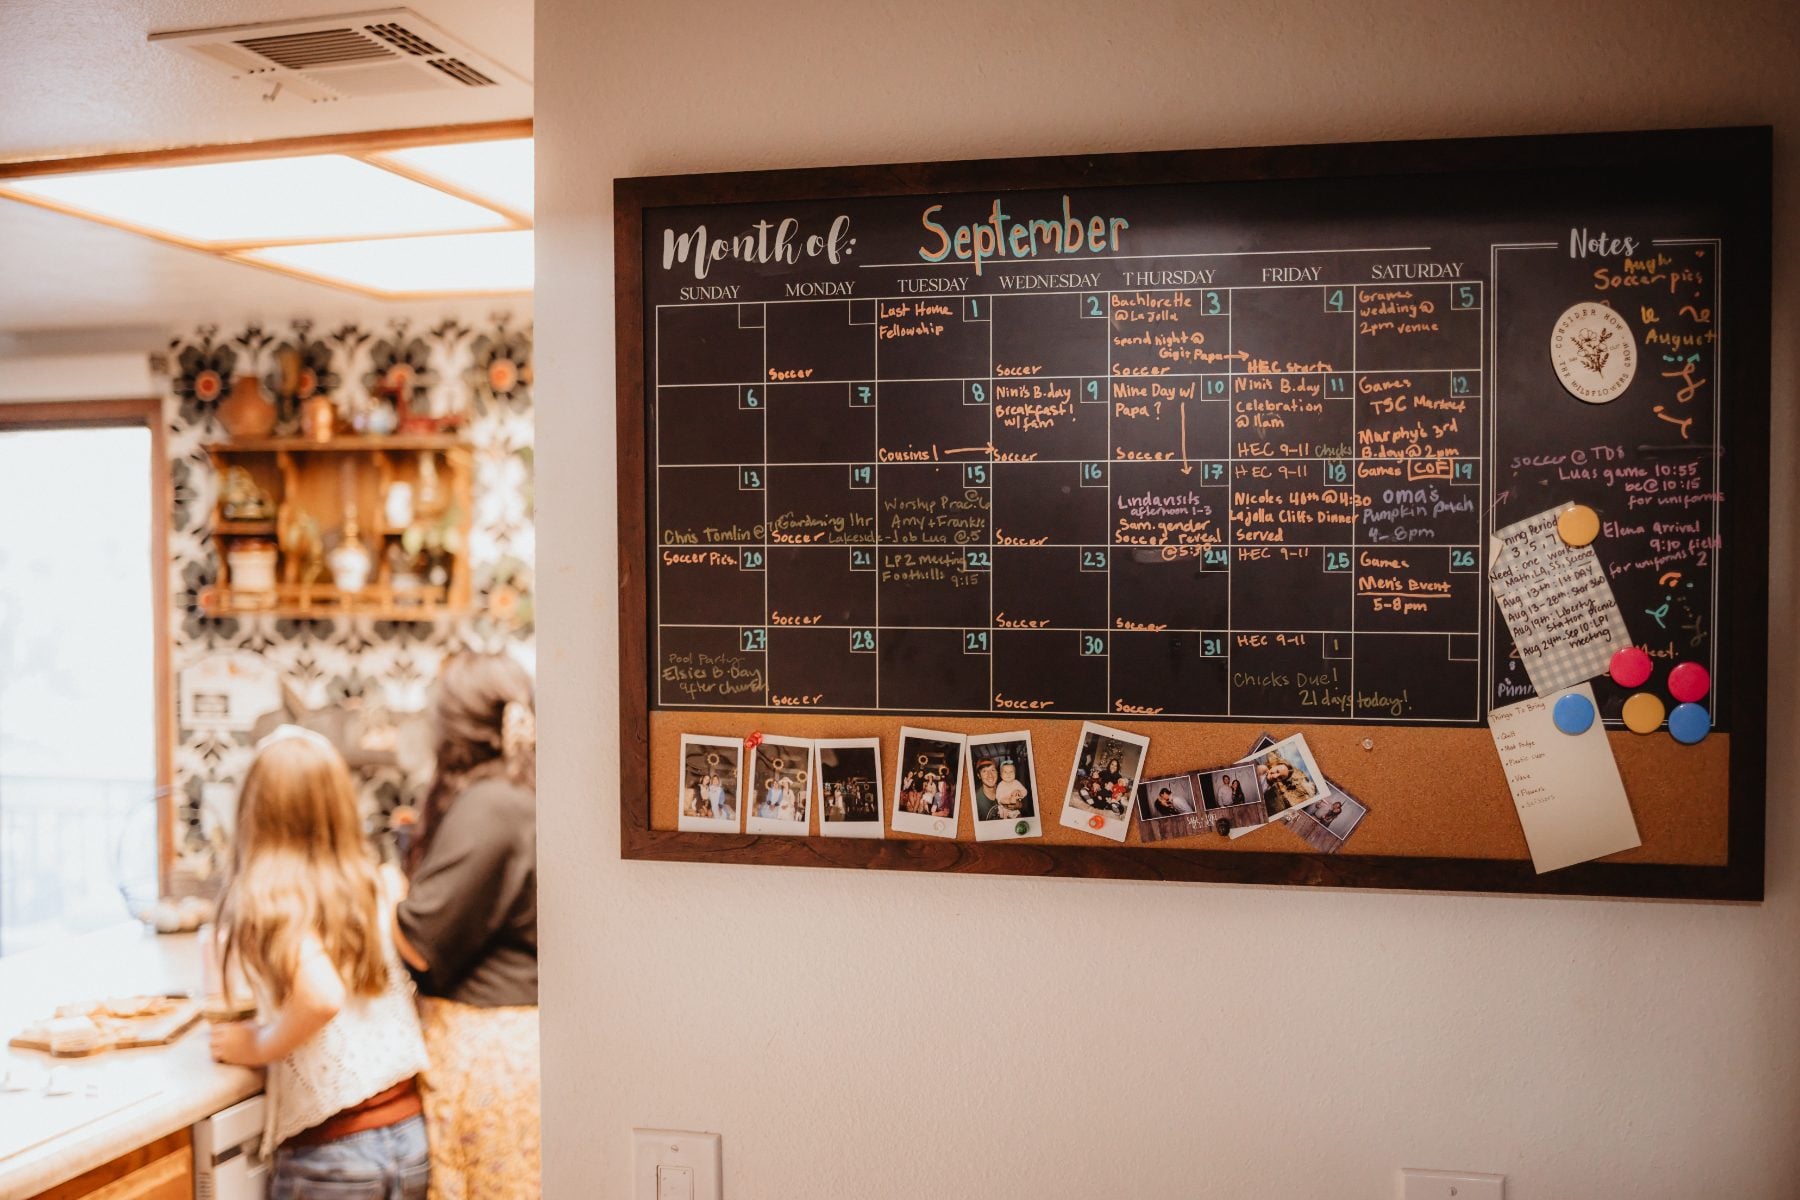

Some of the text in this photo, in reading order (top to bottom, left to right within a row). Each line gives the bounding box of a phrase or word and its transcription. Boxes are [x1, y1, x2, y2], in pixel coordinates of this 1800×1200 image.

[919, 194, 1129, 276] September
[1570, 227, 1640, 258] Notes
[662, 218, 802, 280] Month
[1122, 269, 1216, 286] THURSDAY
[1262, 266, 1322, 282] FRIDAY
[1371, 262, 1464, 280] SATURDAY
[897, 277, 969, 293] TUESDAY
[999, 272, 1101, 289] WEDNESDAY
[680, 284, 740, 300] SUNDAY
[785, 281, 855, 297] MONDAY
[1460, 286, 1474, 308] 5
[1087, 295, 1103, 316] 2
[1207, 291, 1221, 314] 3
[1329, 289, 1343, 312] 4
[880, 302, 953, 318] Last Home
[879, 323, 944, 340] Fellowship
[1360, 321, 1394, 336] 2pm
[768, 367, 813, 381] Soccer
[996, 364, 1042, 376] Soccer
[1112, 363, 1170, 376] Soccer
[972, 383, 985, 402] 8
[1087, 380, 1098, 400] 9
[1151, 383, 1176, 400] Day
[1208, 380, 1224, 395] 10
[1331, 378, 1344, 392] 11
[1358, 376, 1412, 393] Games
[747, 389, 758, 407] 6
[858, 386, 871, 404] 7
[993, 449, 1038, 462] Soccer
[1116, 447, 1175, 460] Soccer
[1238, 442, 1309, 457] HEC 9-11
[967, 465, 985, 484] 15
[1085, 463, 1102, 480] 16
[1204, 463, 1223, 480] 17
[1236, 464, 1307, 479] HEC 9-11
[1329, 463, 1346, 482] 18
[1358, 462, 1401, 478] Games
[1455, 463, 1472, 479] 19
[1655, 461, 1699, 477] 10:55
[744, 471, 760, 487] 13
[1663, 478, 1701, 490] 10:15
[891, 514, 926, 530] Amy
[703, 525, 750, 542] Tomlin
[772, 530, 825, 544] Soccer
[996, 529, 1048, 545] Soccer
[1115, 529, 1168, 545] Soccer
[663, 551, 707, 566] Soccer
[744, 551, 763, 568] 20
[853, 550, 870, 565] 21
[967, 552, 991, 566] 22
[1083, 552, 1106, 568] 23
[1204, 549, 1228, 565] 24
[1238, 547, 1309, 561] HEC 9-11
[1327, 552, 1350, 571] 25
[1452, 550, 1475, 567] 26
[1696, 552, 1708, 567] 2
[1502, 595, 1523, 609] Aug
[772, 611, 822, 625] Soccer
[996, 612, 1050, 628] Soccer
[1116, 617, 1167, 632] Soccer
[1508, 610, 1529, 623] Aug
[1513, 624, 1533, 638] Aug
[743, 629, 767, 650] 27
[852, 630, 875, 650] 28
[966, 632, 987, 651] 29
[1084, 635, 1103, 655] 30
[1205, 638, 1221, 655] 31
[1237, 634, 1305, 647] HEC 9-11
[1523, 644, 1542, 658] Aug
[1233, 671, 1290, 687] Chicks
[772, 694, 823, 707] Soccer
[995, 693, 1053, 710] Soccer
[1115, 699, 1163, 714] Soccer
